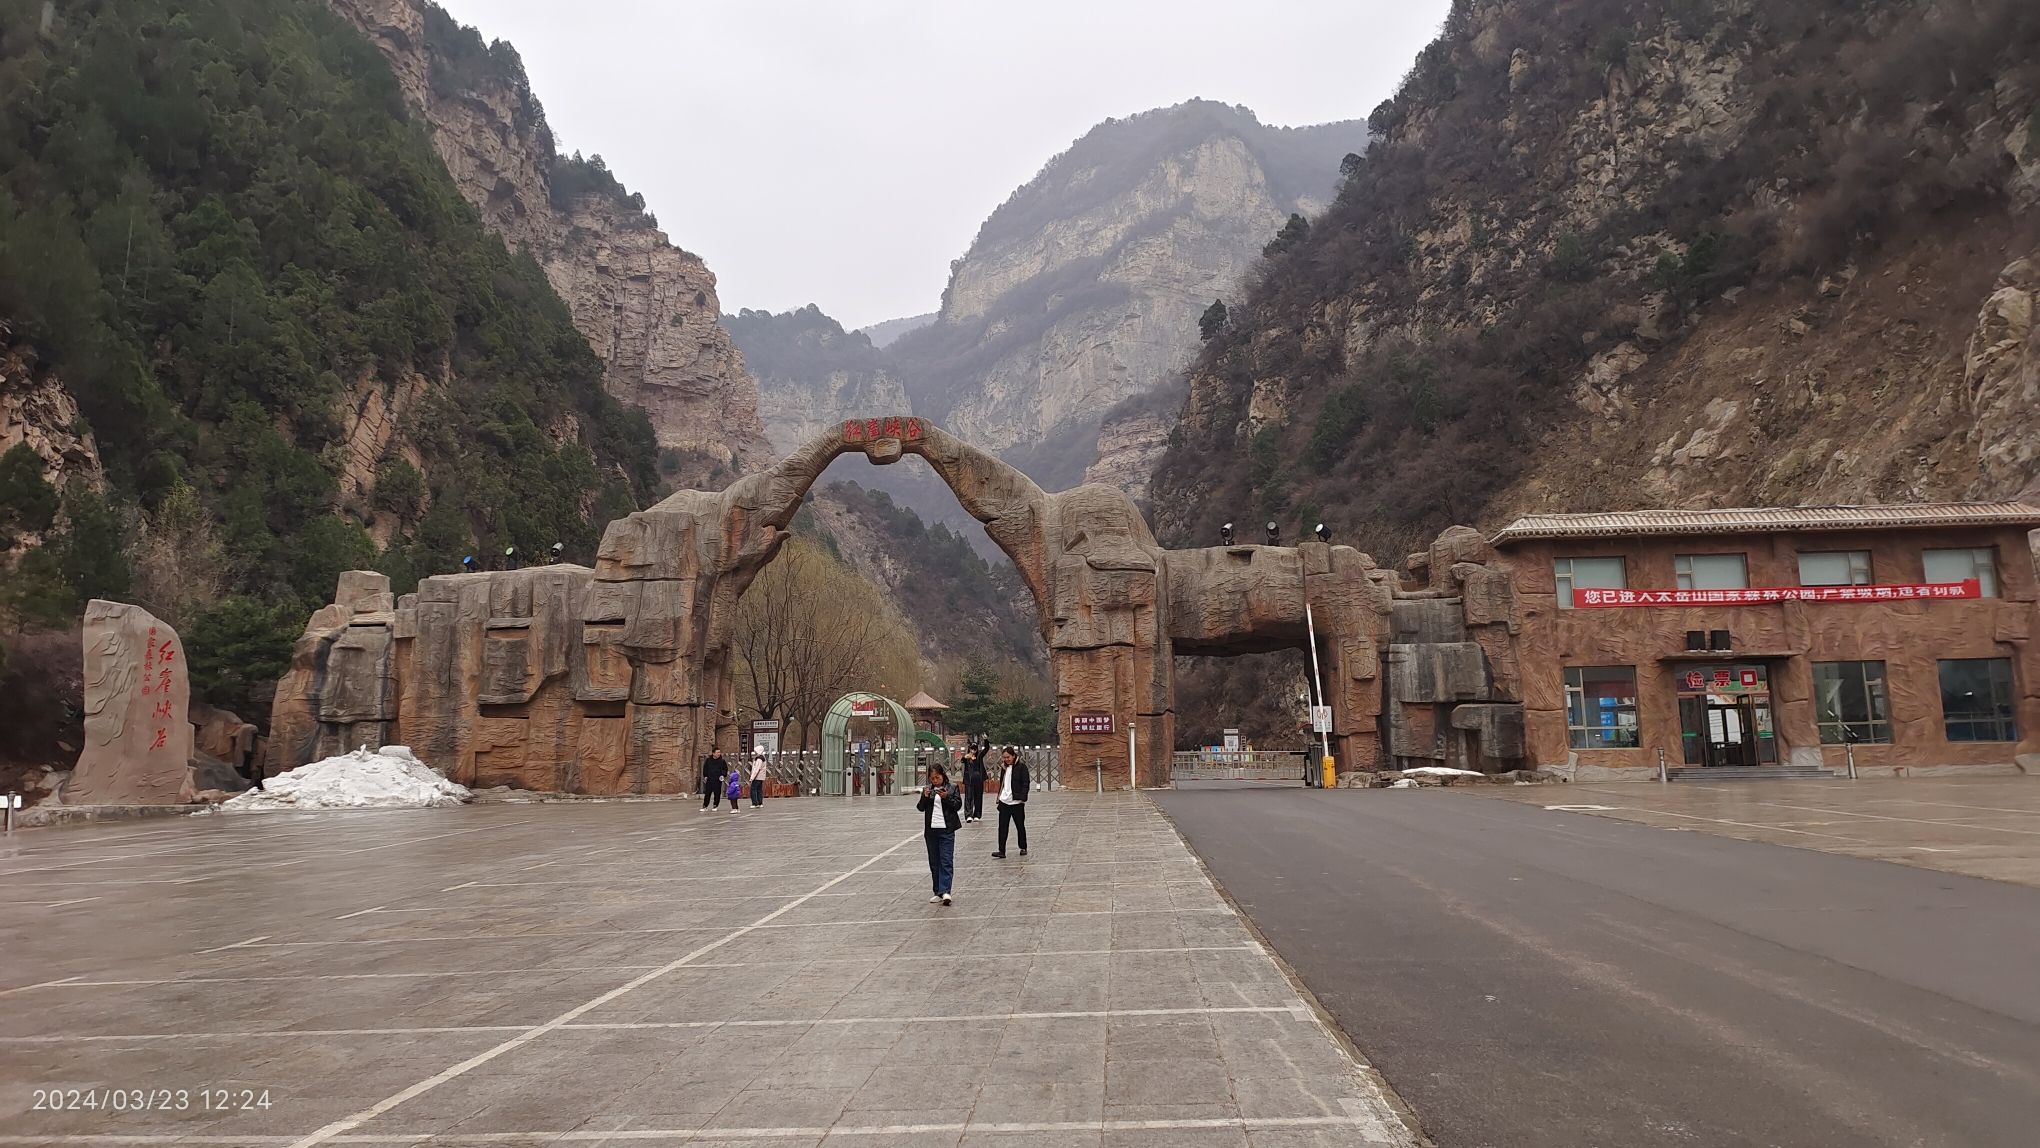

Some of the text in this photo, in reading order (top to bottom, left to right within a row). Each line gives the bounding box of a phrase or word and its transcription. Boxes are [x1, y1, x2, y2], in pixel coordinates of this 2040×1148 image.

[844, 416, 923, 442] 红崖峡谷
[149, 640, 175, 752] 红崖峡谷
